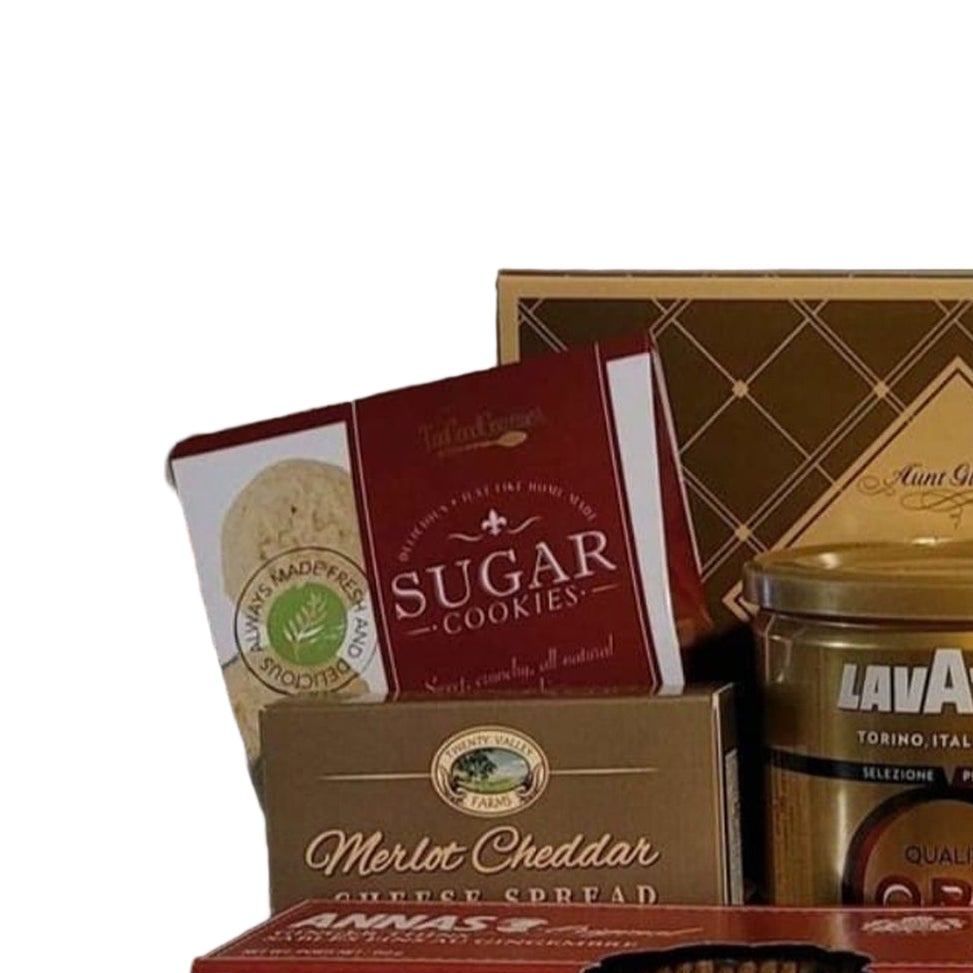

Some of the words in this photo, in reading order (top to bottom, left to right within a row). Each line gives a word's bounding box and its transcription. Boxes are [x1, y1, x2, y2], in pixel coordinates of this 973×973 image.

[893, 463, 946, 486] Aunt
[270, 560, 328, 586] MADE
[327, 565, 367, 612] FRESH
[391, 530, 618, 620] SUGAR
[244, 583, 273, 652] ALWAYS
[443, 585, 579, 634] COOKIES
[347, 616, 368, 659] AND
[260, 657, 351, 690] DELICIOUS
[862, 766, 935, 782] SELEZIONE
[304, 829, 467, 876] Merlot
[471, 825, 661, 874] Cheddar
[504, 884, 658, 905] SPREAD
[289, 912, 499, 932] ANNAS
